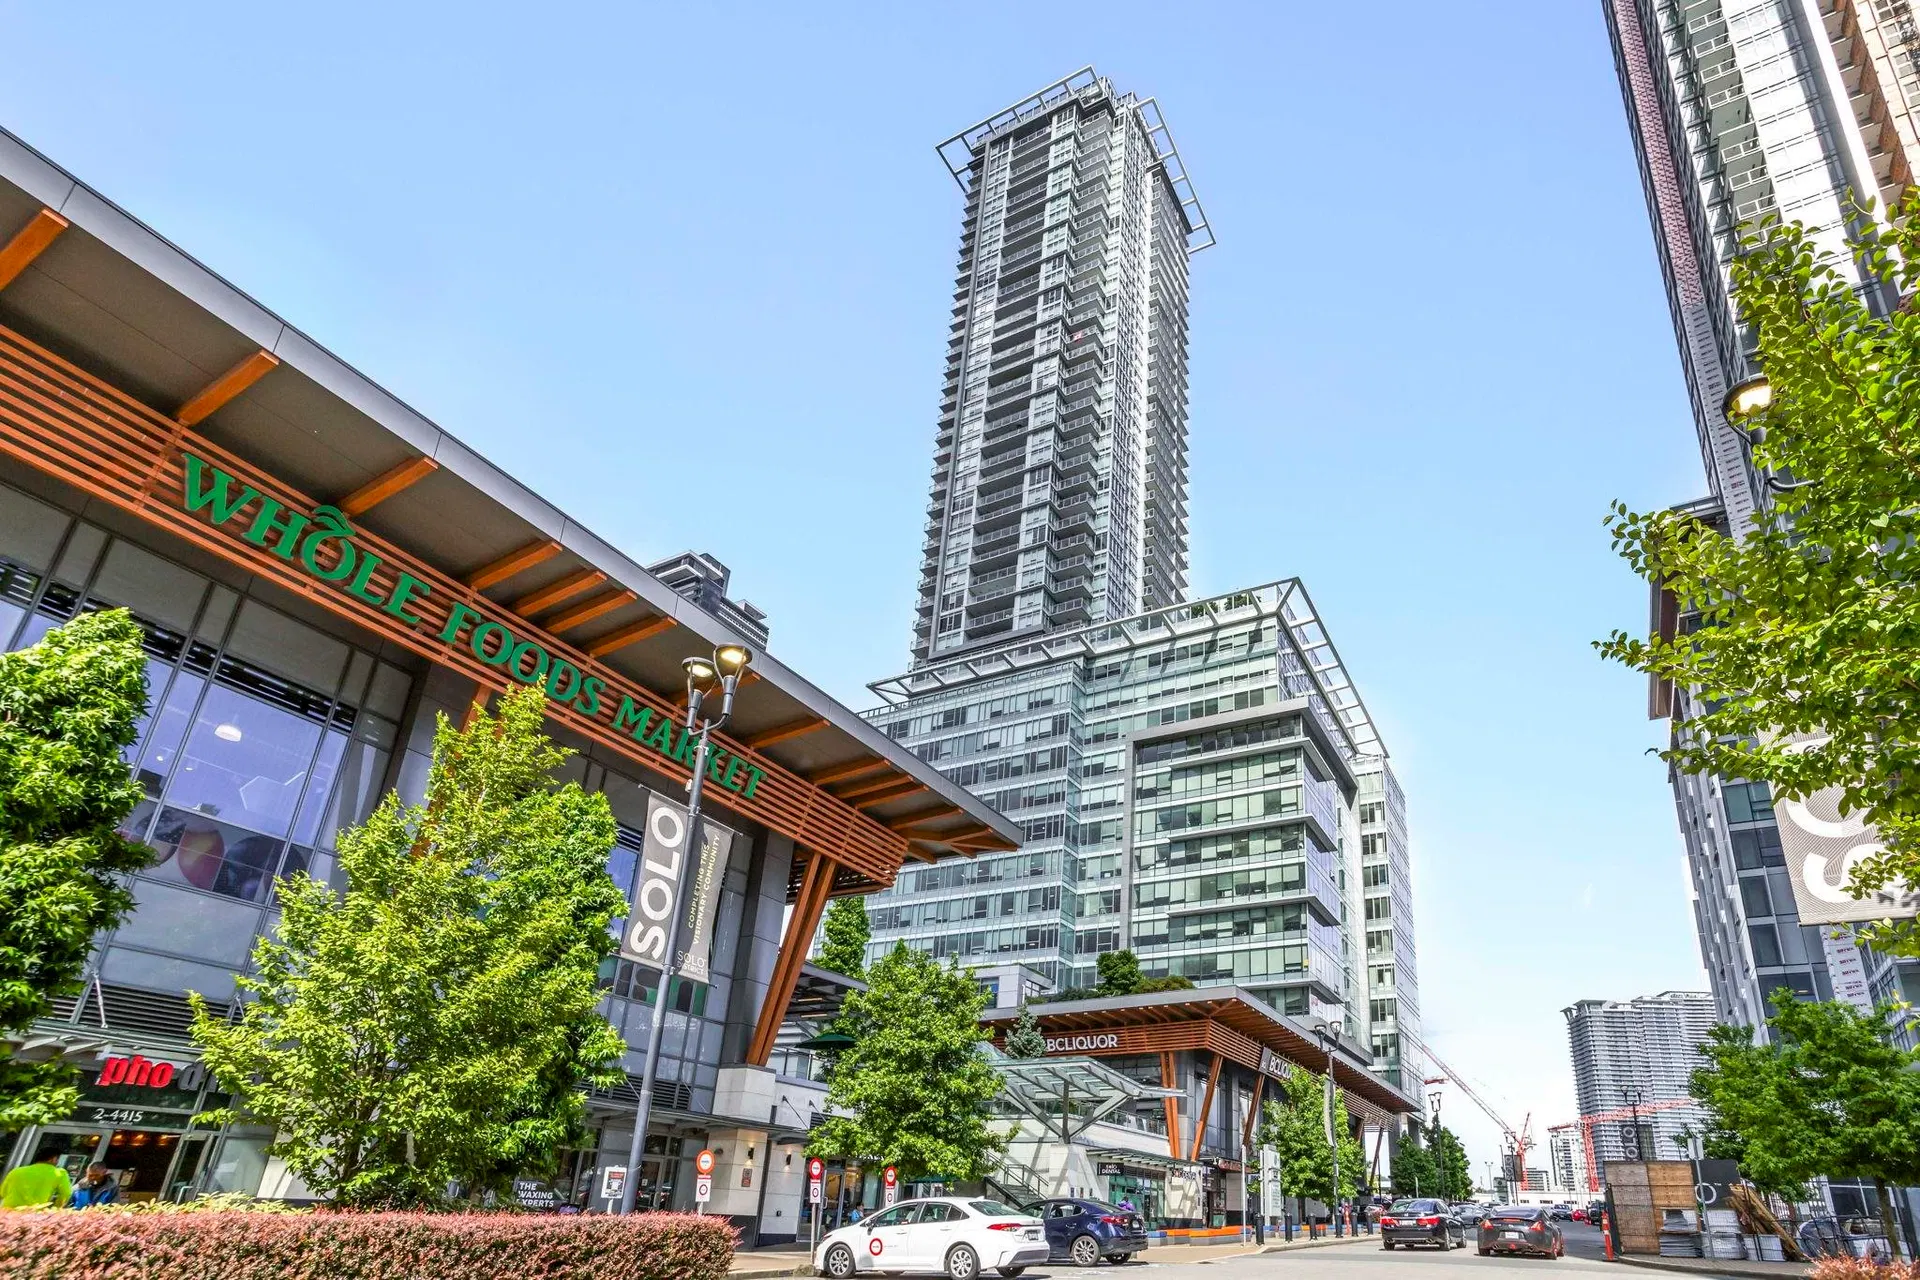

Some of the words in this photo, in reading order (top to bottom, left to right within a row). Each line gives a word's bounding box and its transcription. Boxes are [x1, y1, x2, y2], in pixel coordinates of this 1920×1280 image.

[182, 453, 430, 623] WHOLE
[436, 602, 606, 715] FOODS
[609, 694, 767, 799] MARKET
[630, 806, 684, 960] SOLO
[688, 867, 705, 929] COMPLETING
[700, 844, 710, 865] THIS
[693, 893, 708, 945] VISIONARY
[704, 835, 720, 890] COMMUNITY
[677, 950, 705, 968] SOLO
[1046, 1034, 1118, 1052] BCLIQUOR
[95, 1054, 175, 1088] pho
[93, 1107, 144, 1122] 2-4415
[1622, 1126, 1639, 1160] OLO
[518, 1190, 553, 1199] WAXING
[519, 1182, 537, 1190] THE
[517, 1198, 554, 1207] XPERTS
